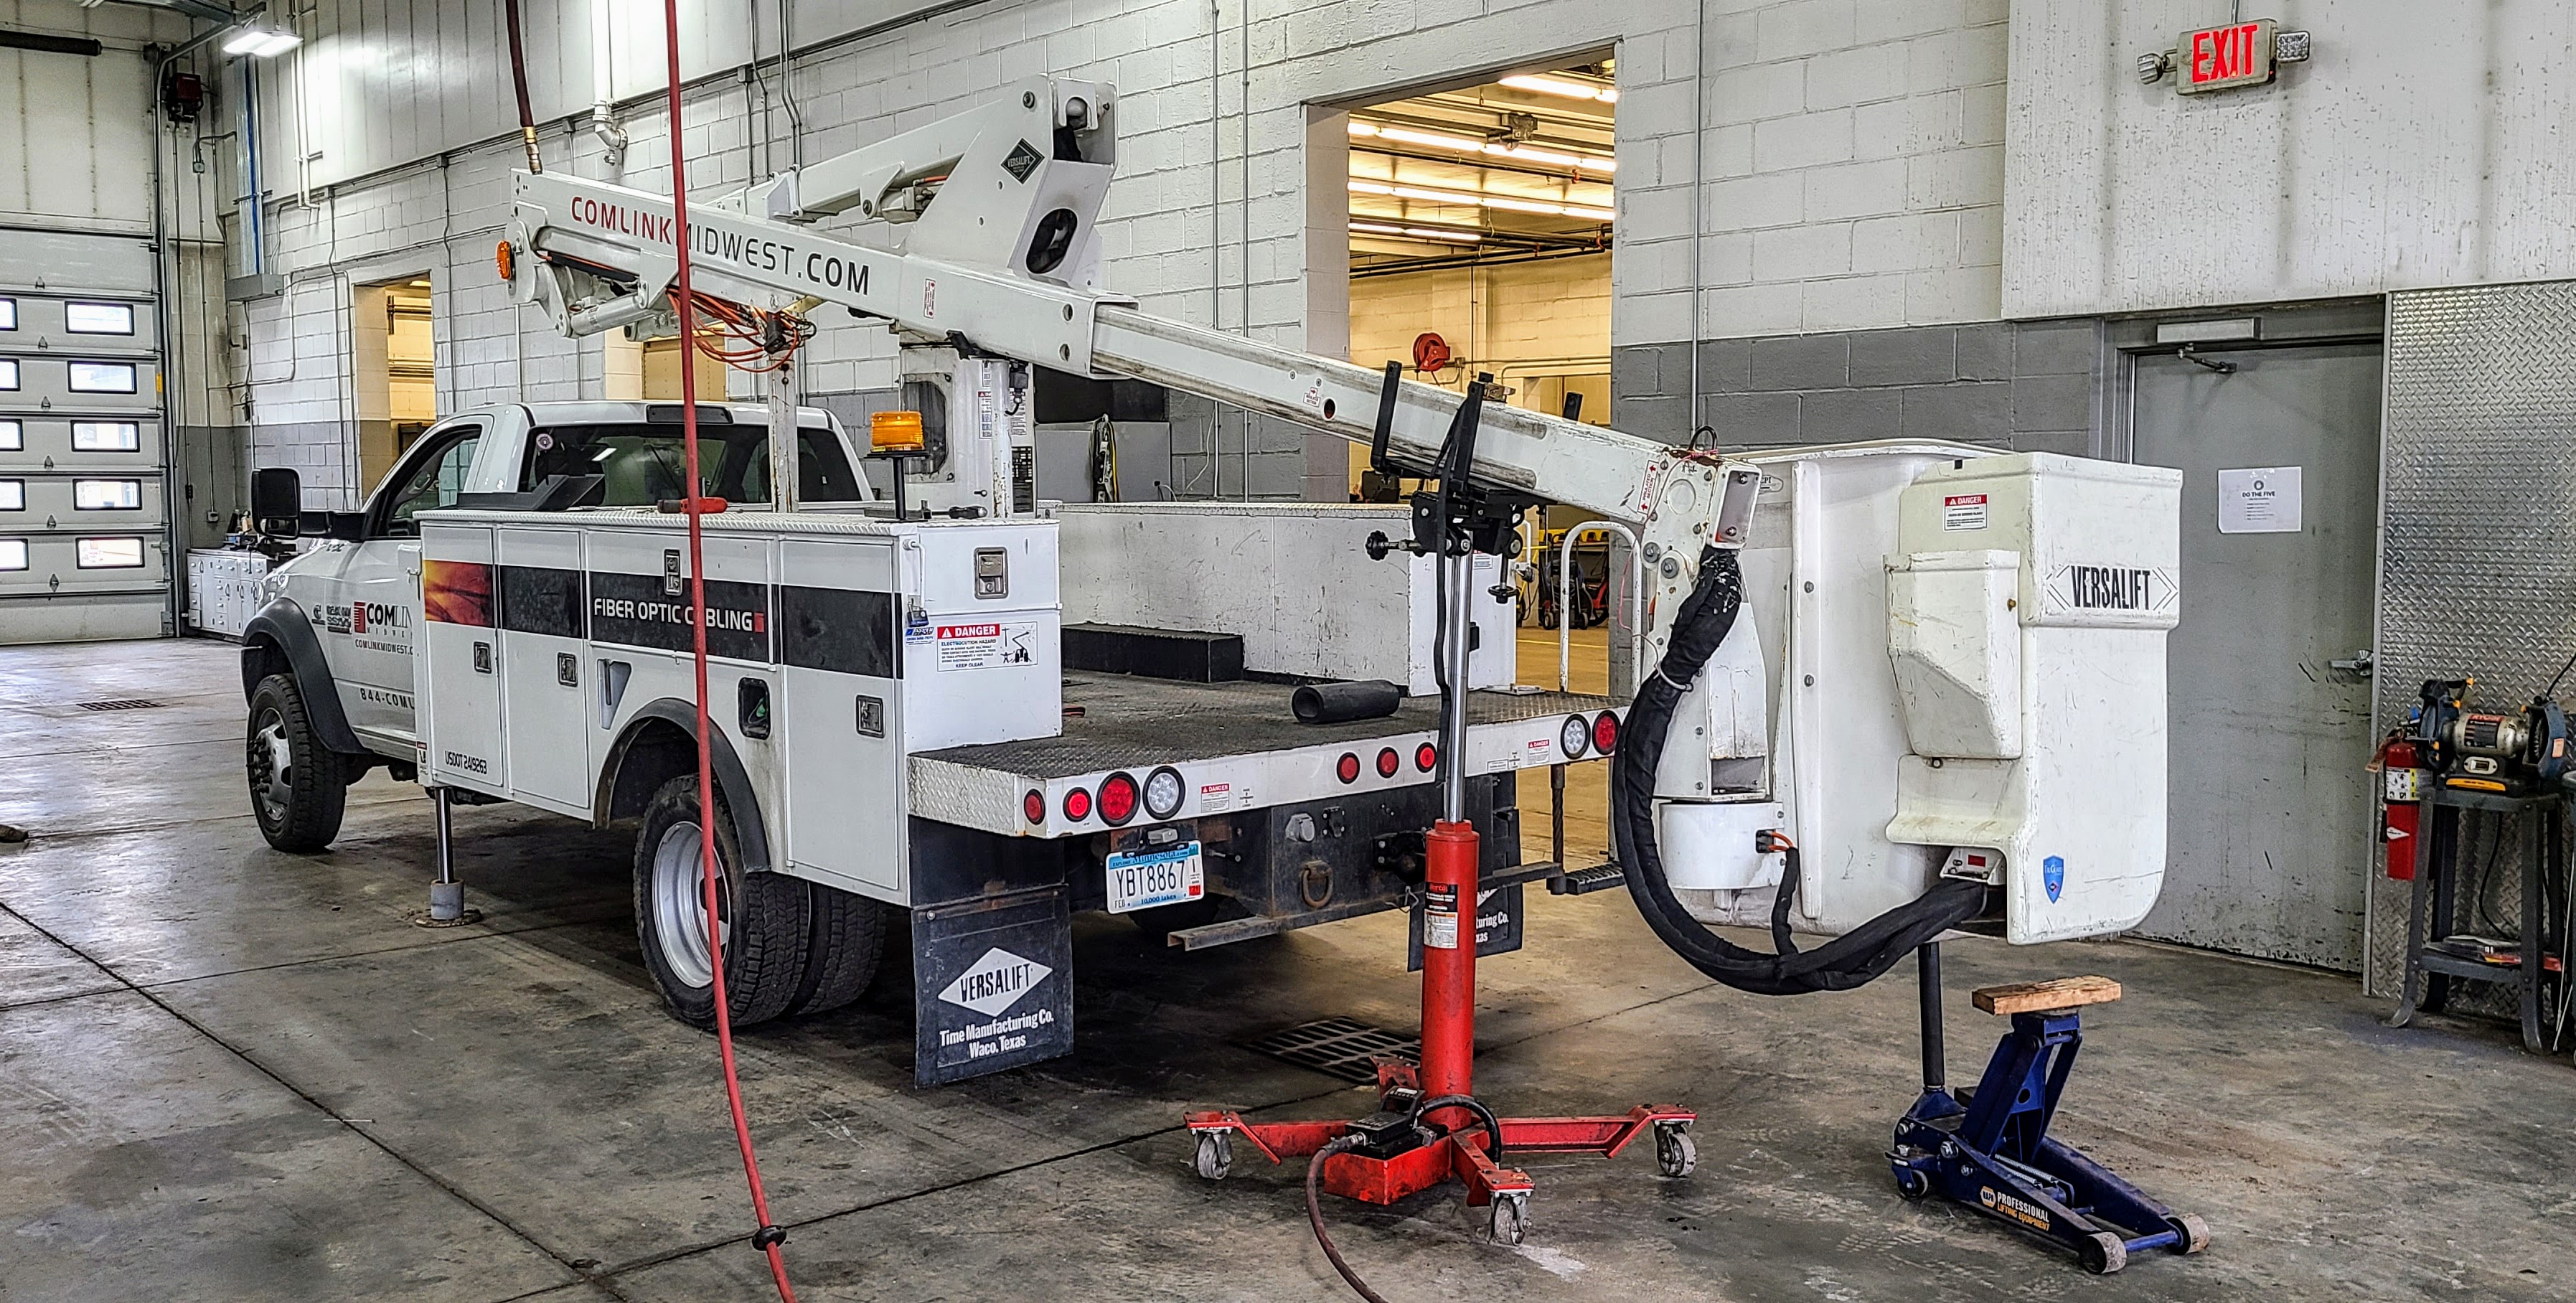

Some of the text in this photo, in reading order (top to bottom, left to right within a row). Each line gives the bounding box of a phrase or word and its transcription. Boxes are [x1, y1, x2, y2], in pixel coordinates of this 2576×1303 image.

[2193, 25, 2257, 83] EXIT
[1957, 496, 1982, 504] DANGER
[2071, 565, 2150, 611] VERSALIFT
[367, 603, 413, 629] COMLIN
[594, 598, 753, 631] FIBER OPTIC CBLING
[954, 625, 996, 637] DANGER
[354, 639, 413, 656] COMLINKMIDWEST.C
[445, 750, 463, 768] USDOT
[1116, 860, 1185, 898] YBT8867
[1498, 911, 1509, 925] Co.
[1476, 932, 1488, 943] xas
[961, 964, 1030, 1002] VERSALIFT
[939, 1009, 1054, 1047] Time Manufacturing Co.
[998, 1035, 1027, 1053] Texas
[1997, 1191, 2049, 1223] PROFESSIONAL
[1997, 1203, 2050, 1231] LIFTING EQUIPMENT
